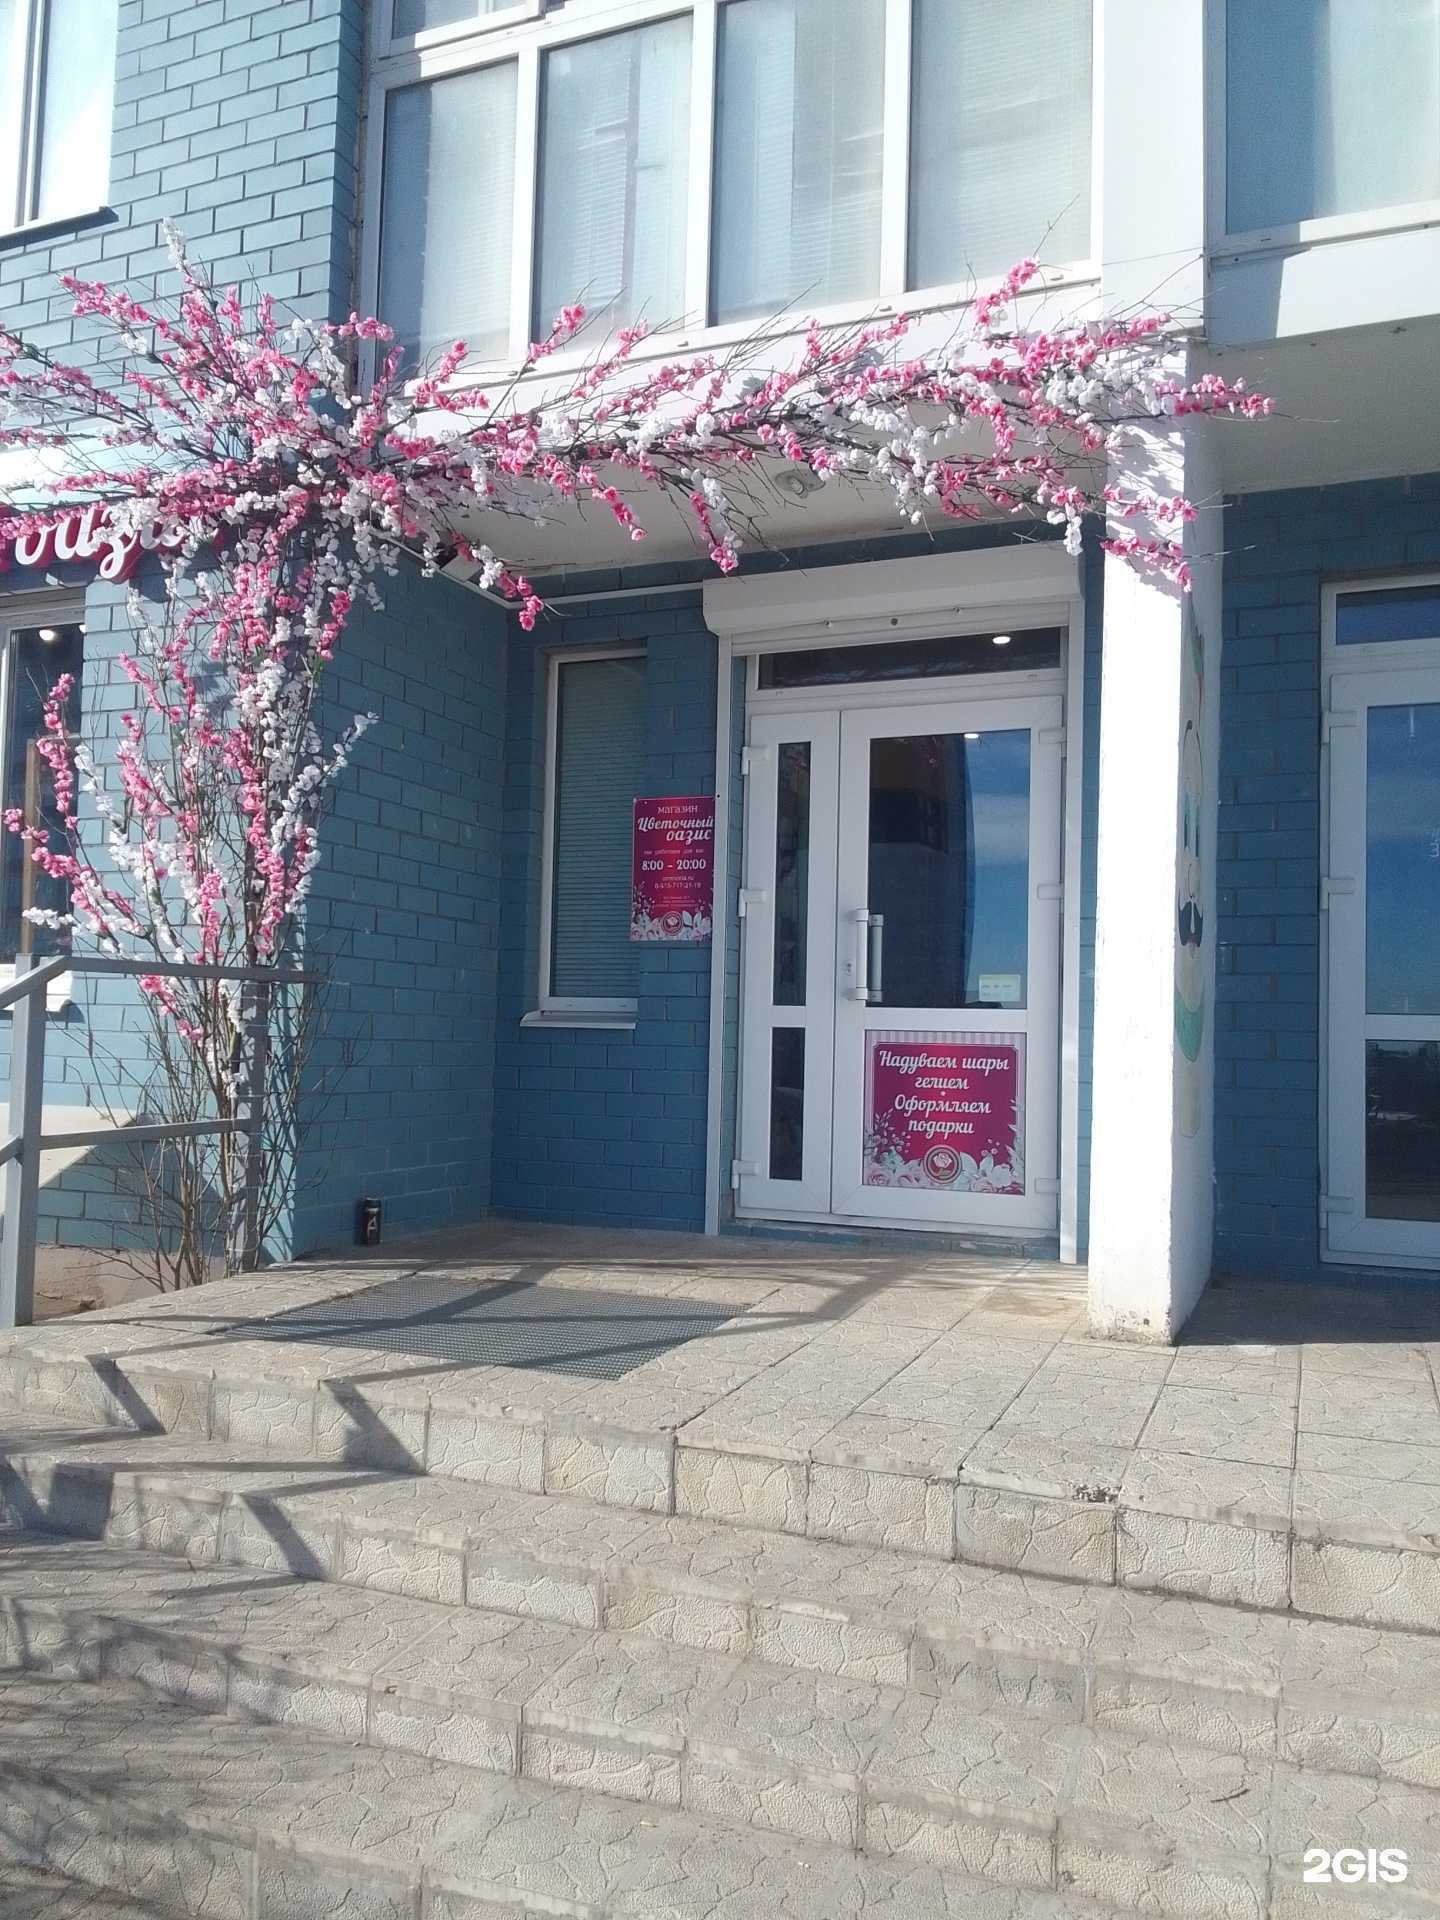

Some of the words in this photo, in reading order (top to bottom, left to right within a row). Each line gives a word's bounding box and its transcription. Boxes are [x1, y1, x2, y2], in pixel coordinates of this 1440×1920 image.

[657, 805, 698, 814] магазин
[637, 816, 714, 832] Цветочный
[666, 829, 712, 845] оазис
[642, 860, 664, 871] 8:00
[677, 858, 706, 870] 20:00
[879, 1050, 957, 1074] Надуваем
[961, 1058, 1010, 1076] шары
[914, 1077, 969, 1090] гелием
[894, 1095, 992, 1118] Оформляем
[908, 1120, 975, 1140] подарки
